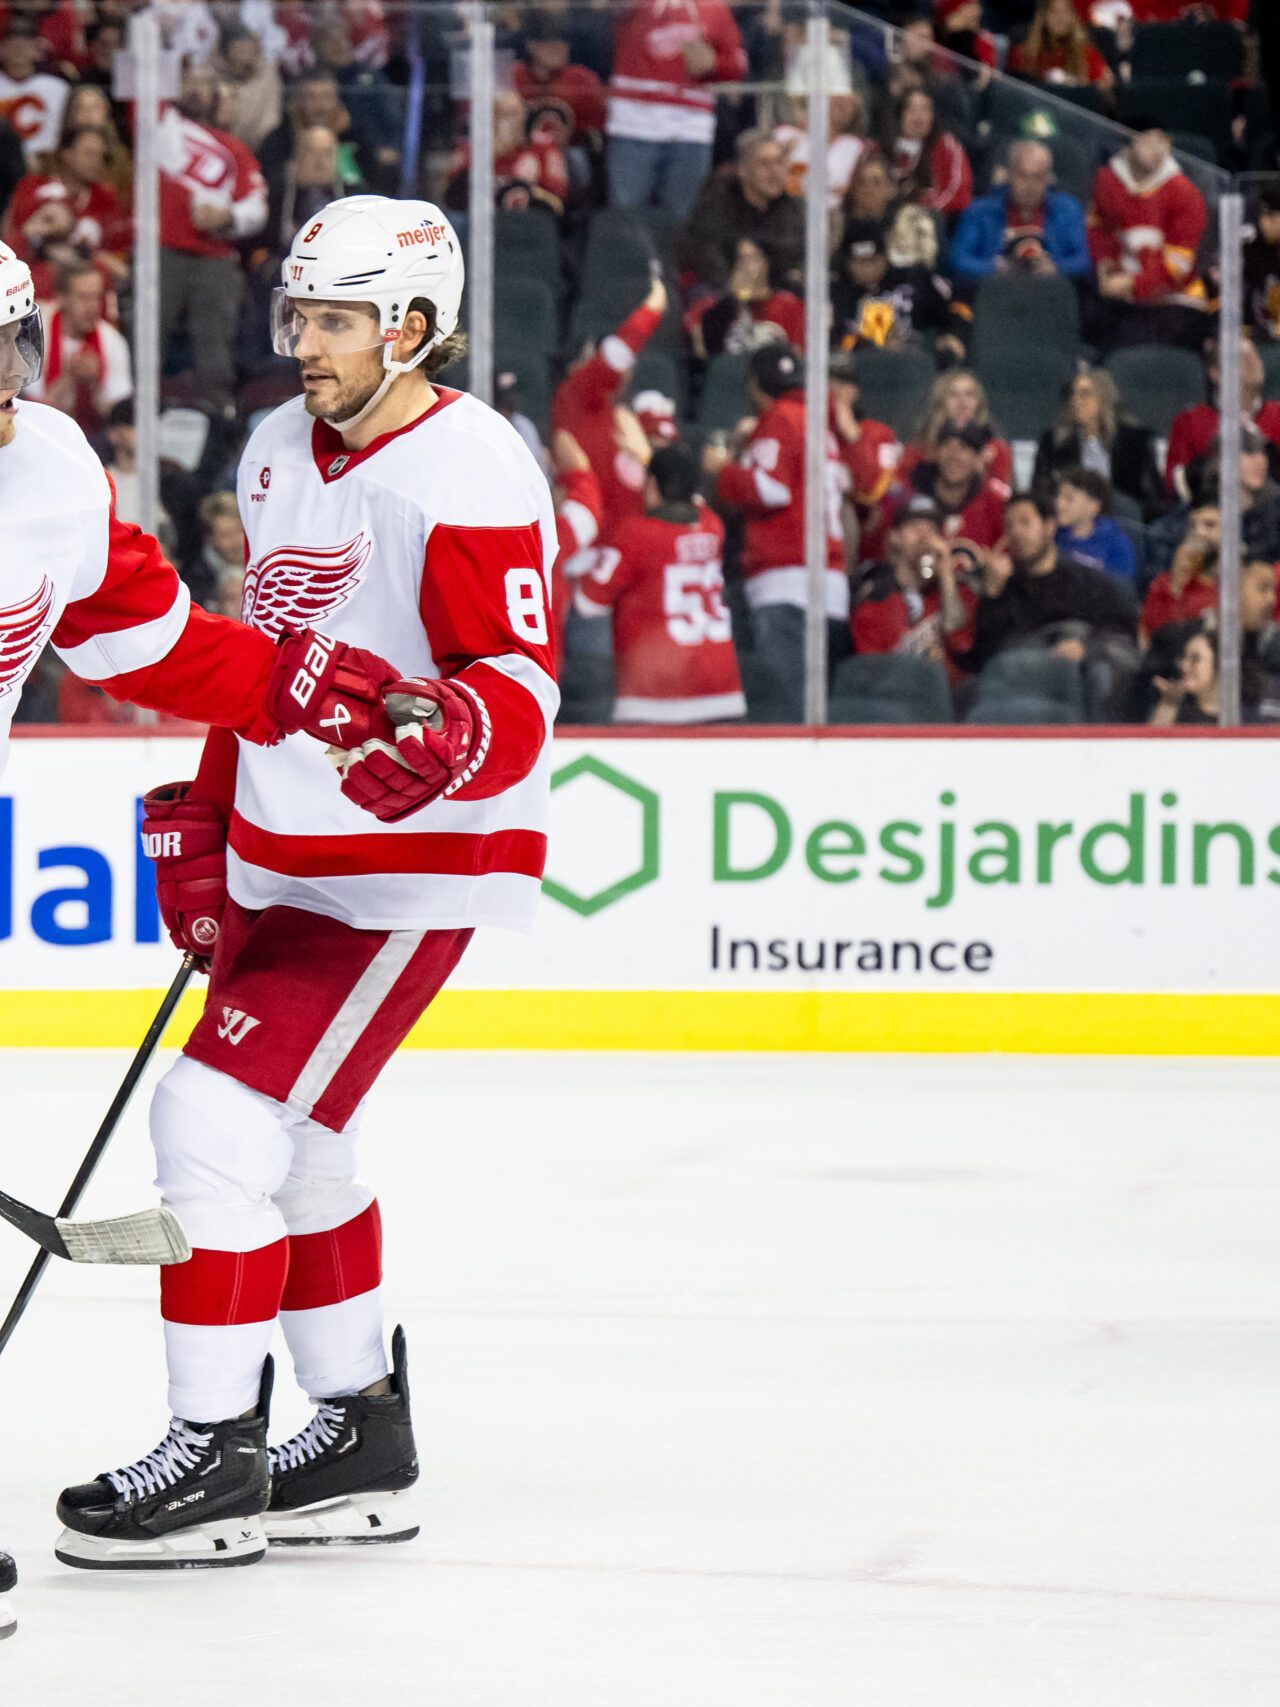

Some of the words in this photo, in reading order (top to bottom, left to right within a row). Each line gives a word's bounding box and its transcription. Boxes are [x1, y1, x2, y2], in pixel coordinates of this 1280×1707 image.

[303, 222, 323, 243] 8
[396, 220, 447, 248] meijer
[504, 567, 549, 645] 8
[710, 925, 995, 973] Insurance
